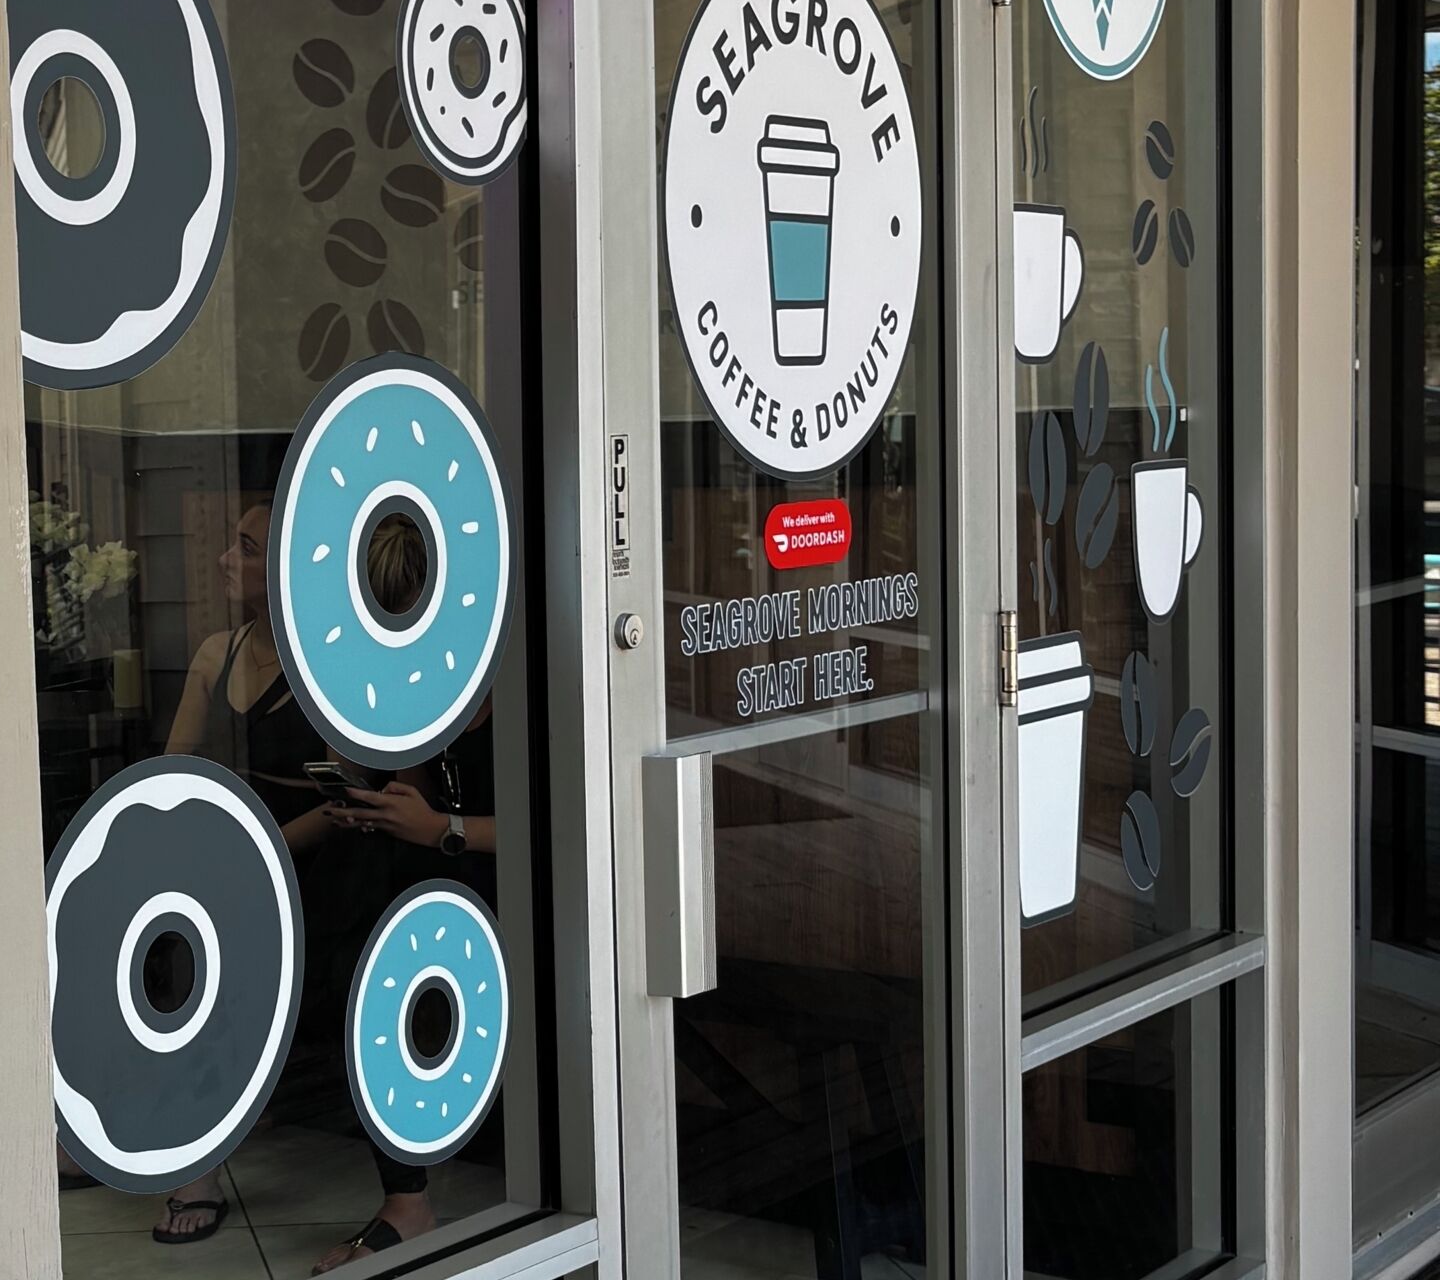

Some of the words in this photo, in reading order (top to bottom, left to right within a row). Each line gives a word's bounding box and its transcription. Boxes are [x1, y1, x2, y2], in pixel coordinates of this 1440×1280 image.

[696, 299, 782, 441] COFFEE
[789, 407, 809, 450] &
[815, 302, 900, 442] DONUTS
[613, 438, 626, 546] PULL
[782, 516, 794, 528] We
[795, 513, 819, 527] deliver
[820, 511, 835, 524] with
[791, 529, 845, 549] DOORDASH
[680, 590, 801, 657] SEAGROVE
[807, 572, 919, 635] MORNINGS
[736, 657, 808, 718] START
[813, 646, 874, 703] HERE.
